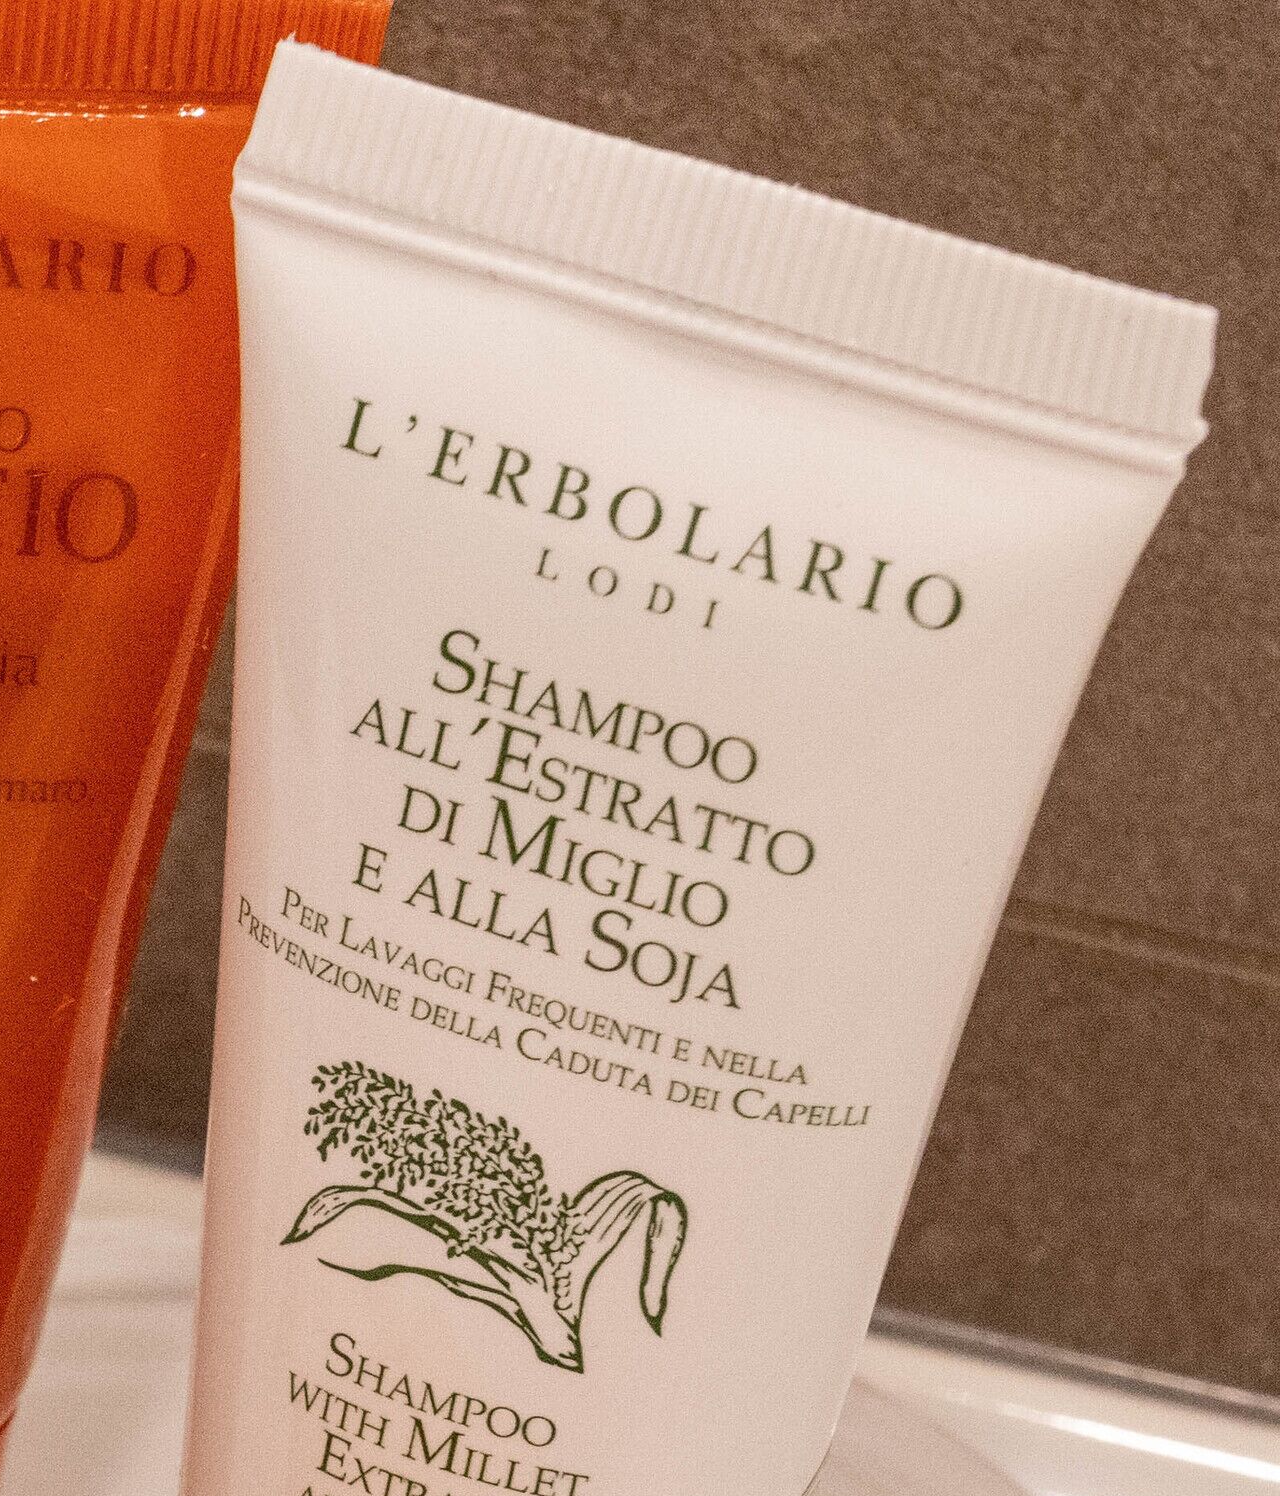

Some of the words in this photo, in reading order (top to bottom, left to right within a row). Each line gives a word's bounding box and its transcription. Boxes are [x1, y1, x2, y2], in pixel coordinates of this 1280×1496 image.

[340, 397, 964, 630] L'ERBOLARIO
[534, 548, 720, 629] LODI
[432, 629, 758, 783] SHAMPOO
[352, 842, 390, 893] E
[403, 867, 561, 956] ALLA
[584, 908, 742, 1009] SOJA
[398, 783, 465, 847] DI
[478, 796, 728, 928] MIGLIO
[237, 895, 400, 1012] PREVENZIONE
[409, 996, 503, 1050] DELLA
[517, 1027, 653, 1097] CADUTA
[665, 1078, 722, 1113] DEI
[732, 1087, 872, 1128] CAPELLI
[280, 886, 329, 938] PER
[338, 914, 476, 994] LAVAGGI
[484, 969, 662, 1055] FREQUENTI
[672, 1037, 692, 1063] E
[701, 1045, 809, 1086] NELLA
[287, 1371, 388, 1448] WITH
[325, 1332, 556, 1448] SHAMPOO
